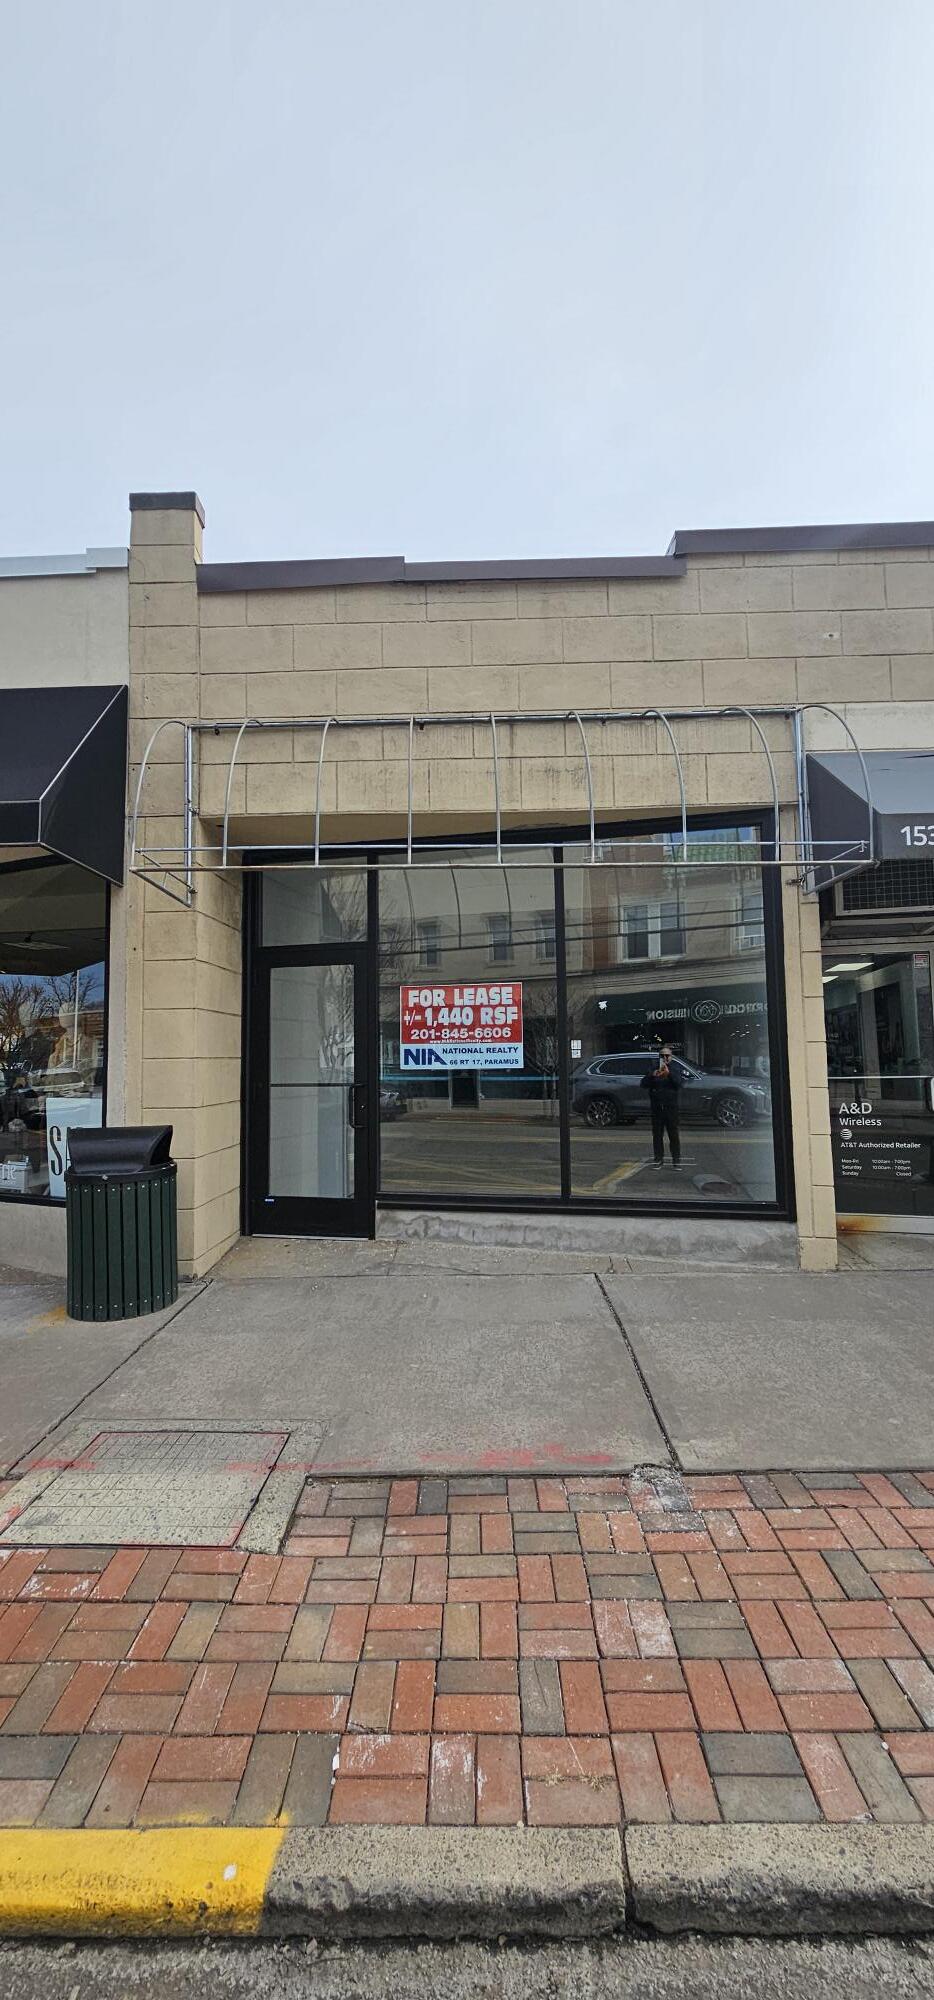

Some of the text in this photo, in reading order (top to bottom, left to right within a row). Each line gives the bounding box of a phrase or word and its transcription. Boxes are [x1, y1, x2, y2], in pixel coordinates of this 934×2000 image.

[408, 987, 513, 1007] FOR LEASE
[480, 1006, 518, 1025] RSF
[410, 1027, 512, 1040] 201-845-6606
[403, 1048, 448, 1066] NIA
[442, 1046, 519, 1055] NATIONAL REALTY
[839, 1102, 872, 1115] A&D
[839, 1117, 882, 1127] Wireless
